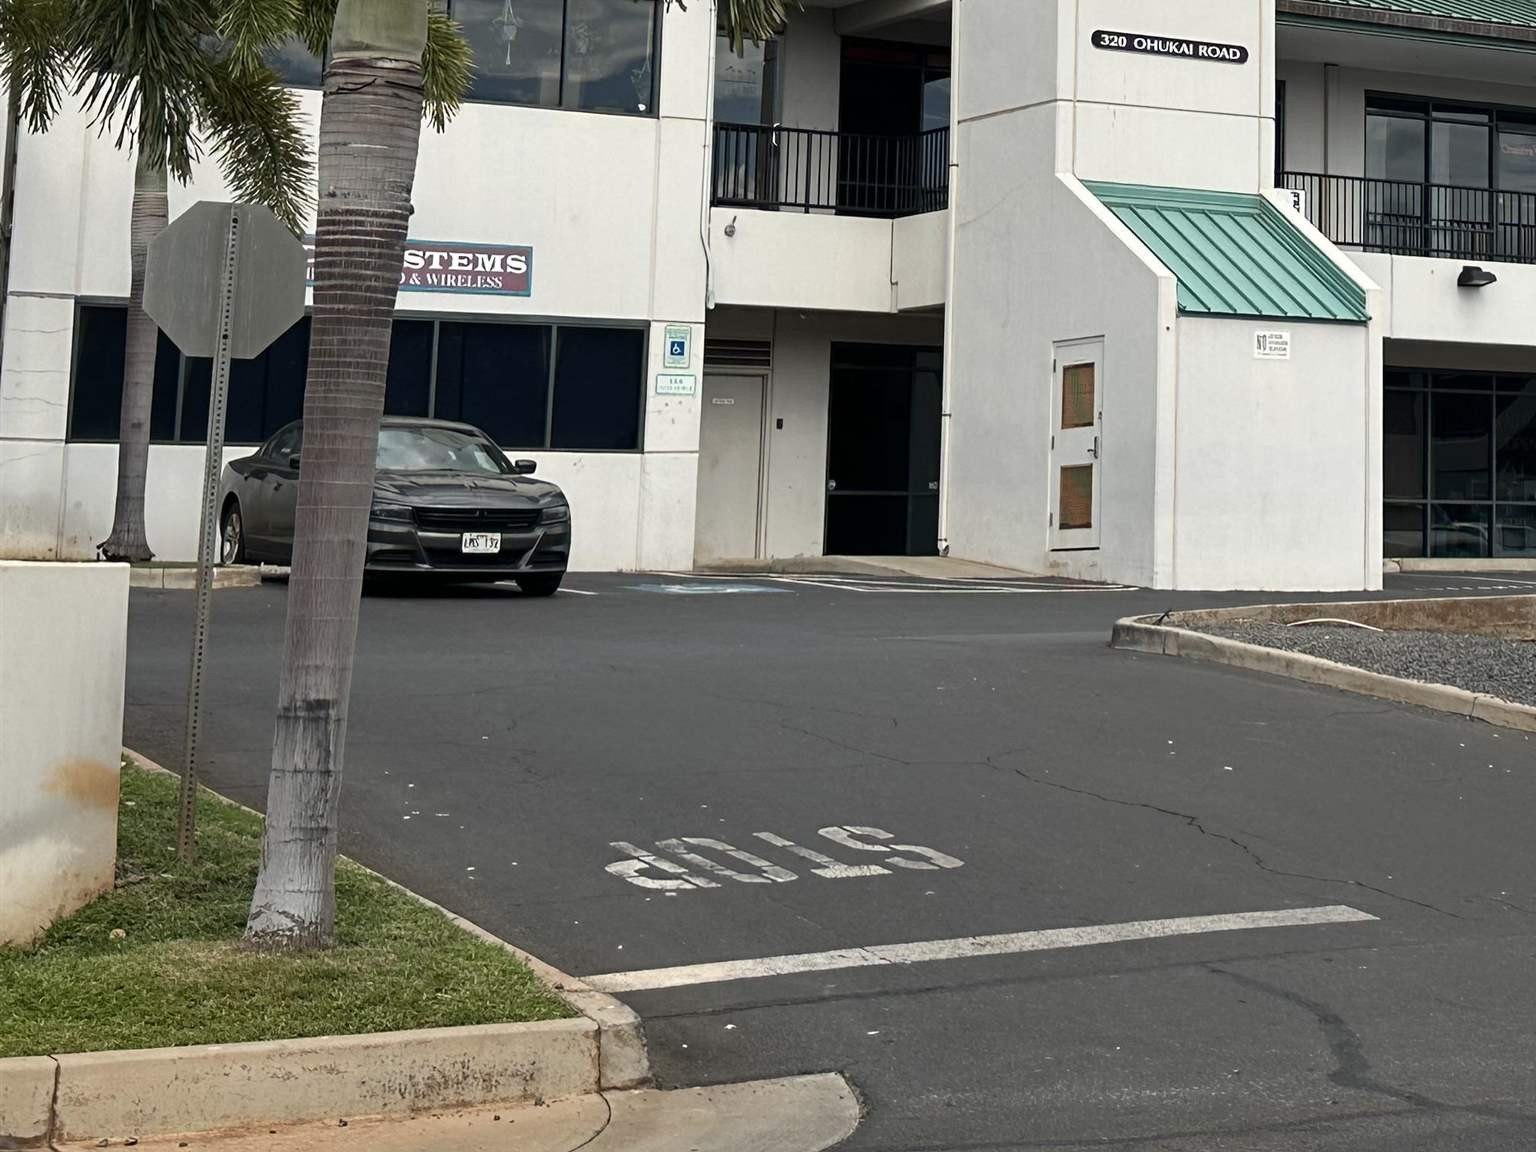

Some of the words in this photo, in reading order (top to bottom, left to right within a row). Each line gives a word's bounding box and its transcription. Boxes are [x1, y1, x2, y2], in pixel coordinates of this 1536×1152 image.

[1099, 34, 1127, 47] 320
[1133, 37, 1194, 56] OHUKAI
[1198, 45, 1241, 60] ROAD
[403, 250, 528, 274] STEMS
[427, 274, 503, 289] WIRELESS
[604, 825, 965, 890] STOP
